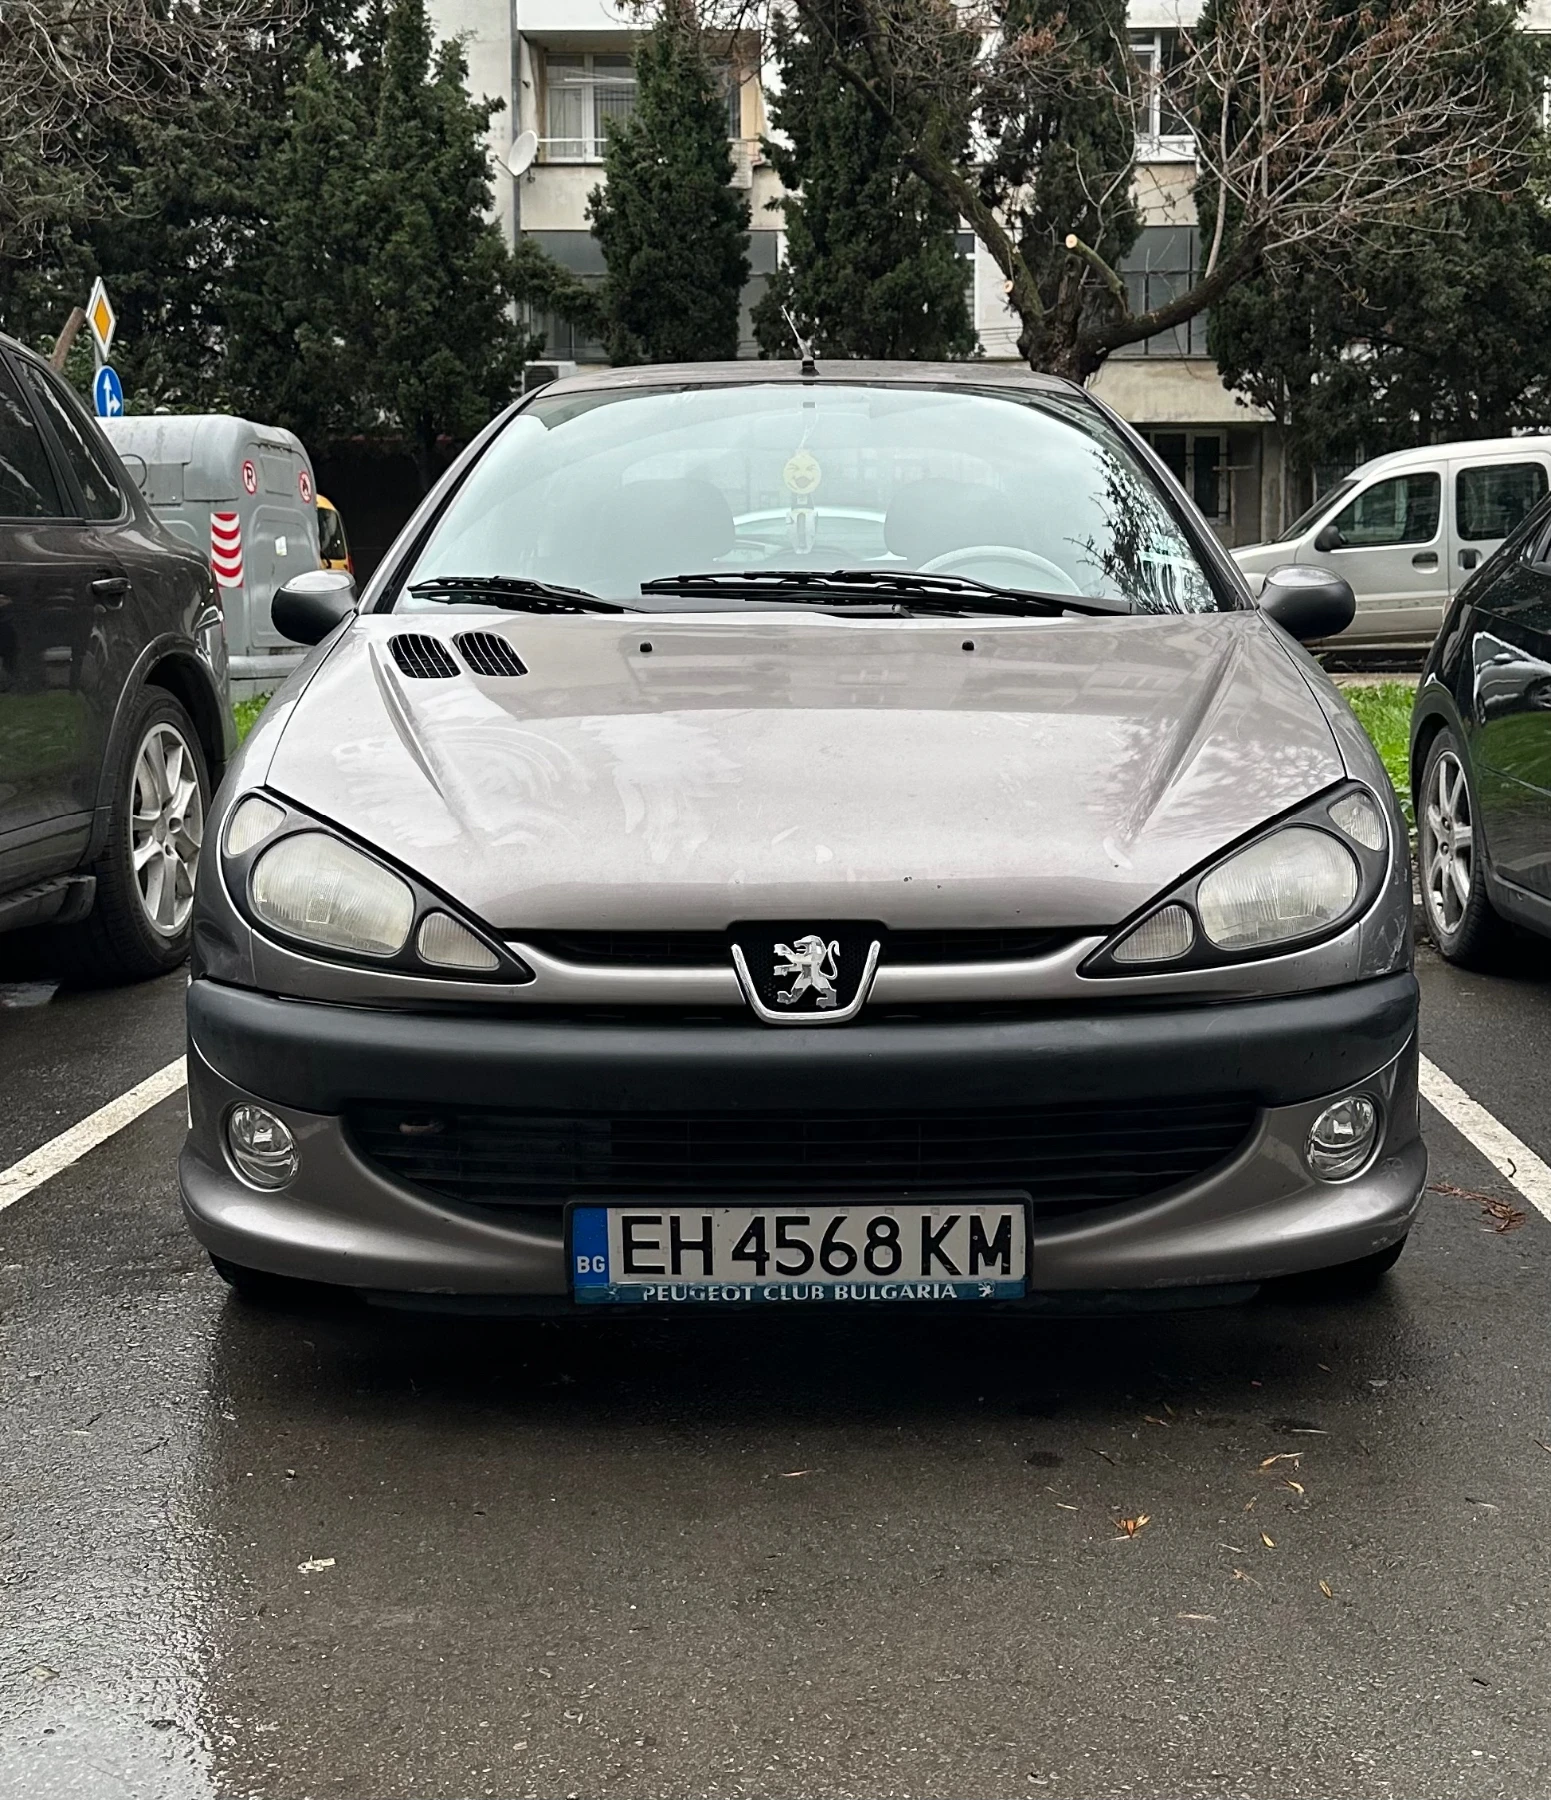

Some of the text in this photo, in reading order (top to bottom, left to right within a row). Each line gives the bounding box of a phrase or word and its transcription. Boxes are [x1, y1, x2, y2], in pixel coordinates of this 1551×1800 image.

[621, 1214, 1013, 1276] EH 4568 KM
[576, 1255, 606, 1273] BG
[643, 1283, 957, 1300] PEUGEOT CLUB BULGARIA
